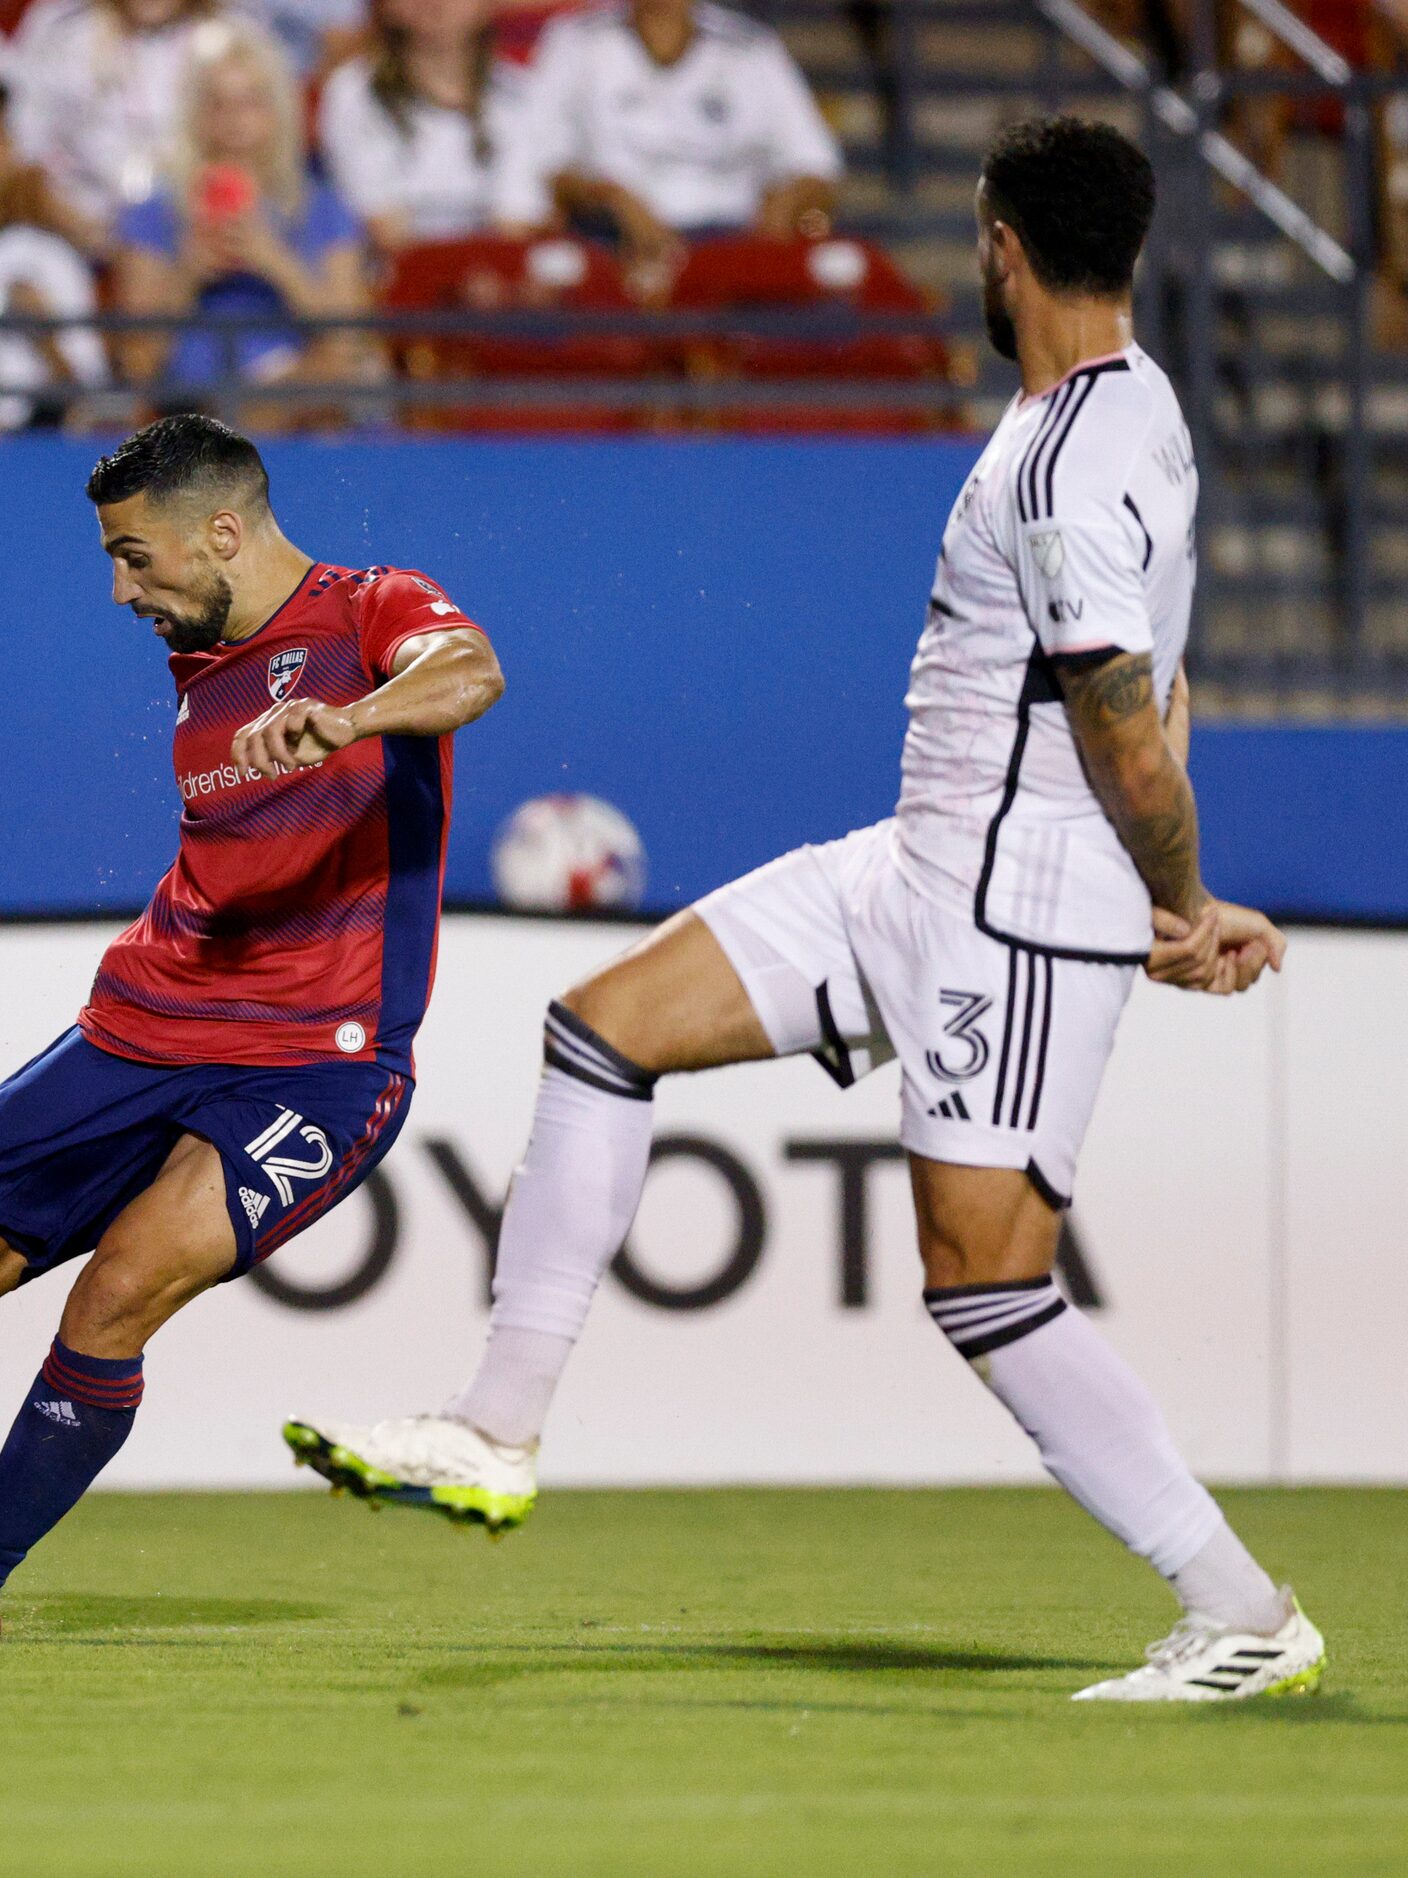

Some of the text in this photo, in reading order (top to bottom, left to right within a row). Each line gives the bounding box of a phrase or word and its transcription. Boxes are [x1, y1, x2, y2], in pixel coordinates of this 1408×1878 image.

[272, 651, 304, 671] FC DALLAS
[342, 1030, 358, 1043] LH
[926, 987, 994, 1083] 3
[244, 1103, 333, 1207] 12
[238, 1186, 259, 1229] adidas
